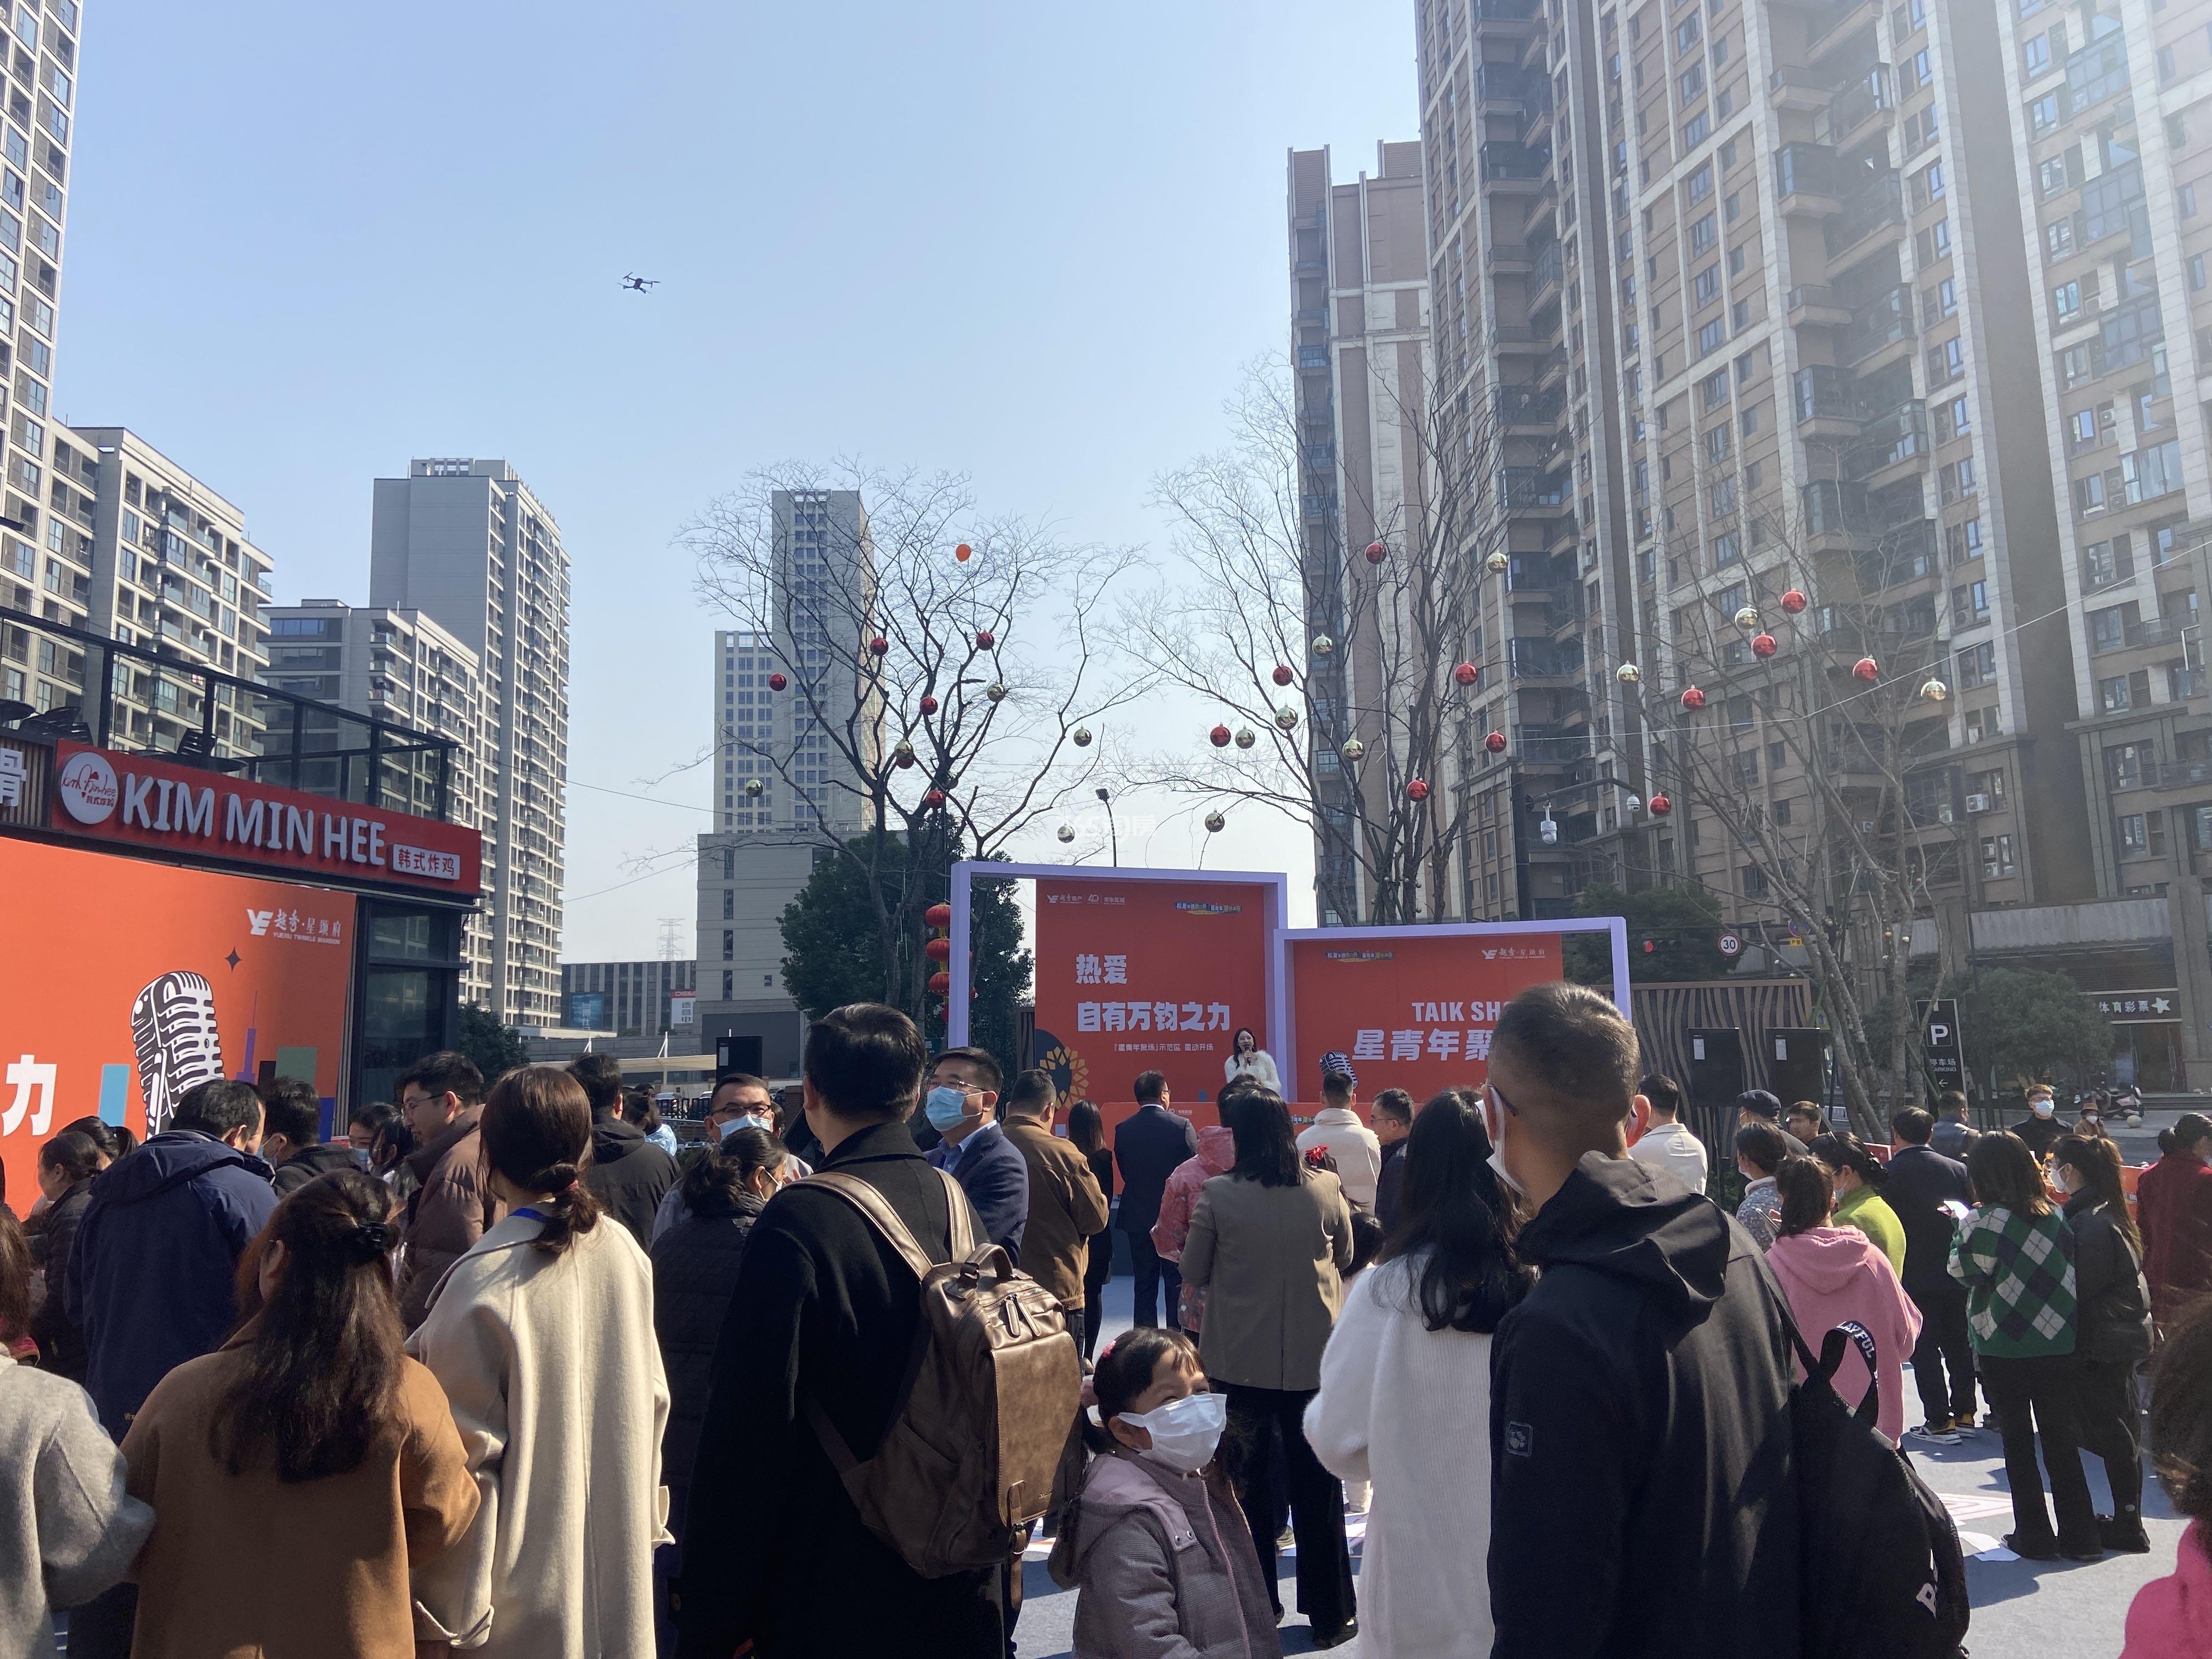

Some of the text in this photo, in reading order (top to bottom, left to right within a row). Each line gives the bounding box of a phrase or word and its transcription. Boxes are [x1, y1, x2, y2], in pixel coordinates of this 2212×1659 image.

[123, 772, 385, 865] KIM MIN HEE
[398, 848, 454, 876] 韩式炸鸡
[1723, 940, 1736, 950] 30
[1076, 953, 1128, 984] 热爱
[1077, 1001, 1231, 1032] 自有万钧之力
[1471, 1001, 1510, 1022] SH
[2099, 1000, 2149, 1014] 体育彩票
[1931, 1025, 1948, 1045] P
[1929, 1058, 1956, 1066] 停车场
[1, 1054, 57, 1137] 力
